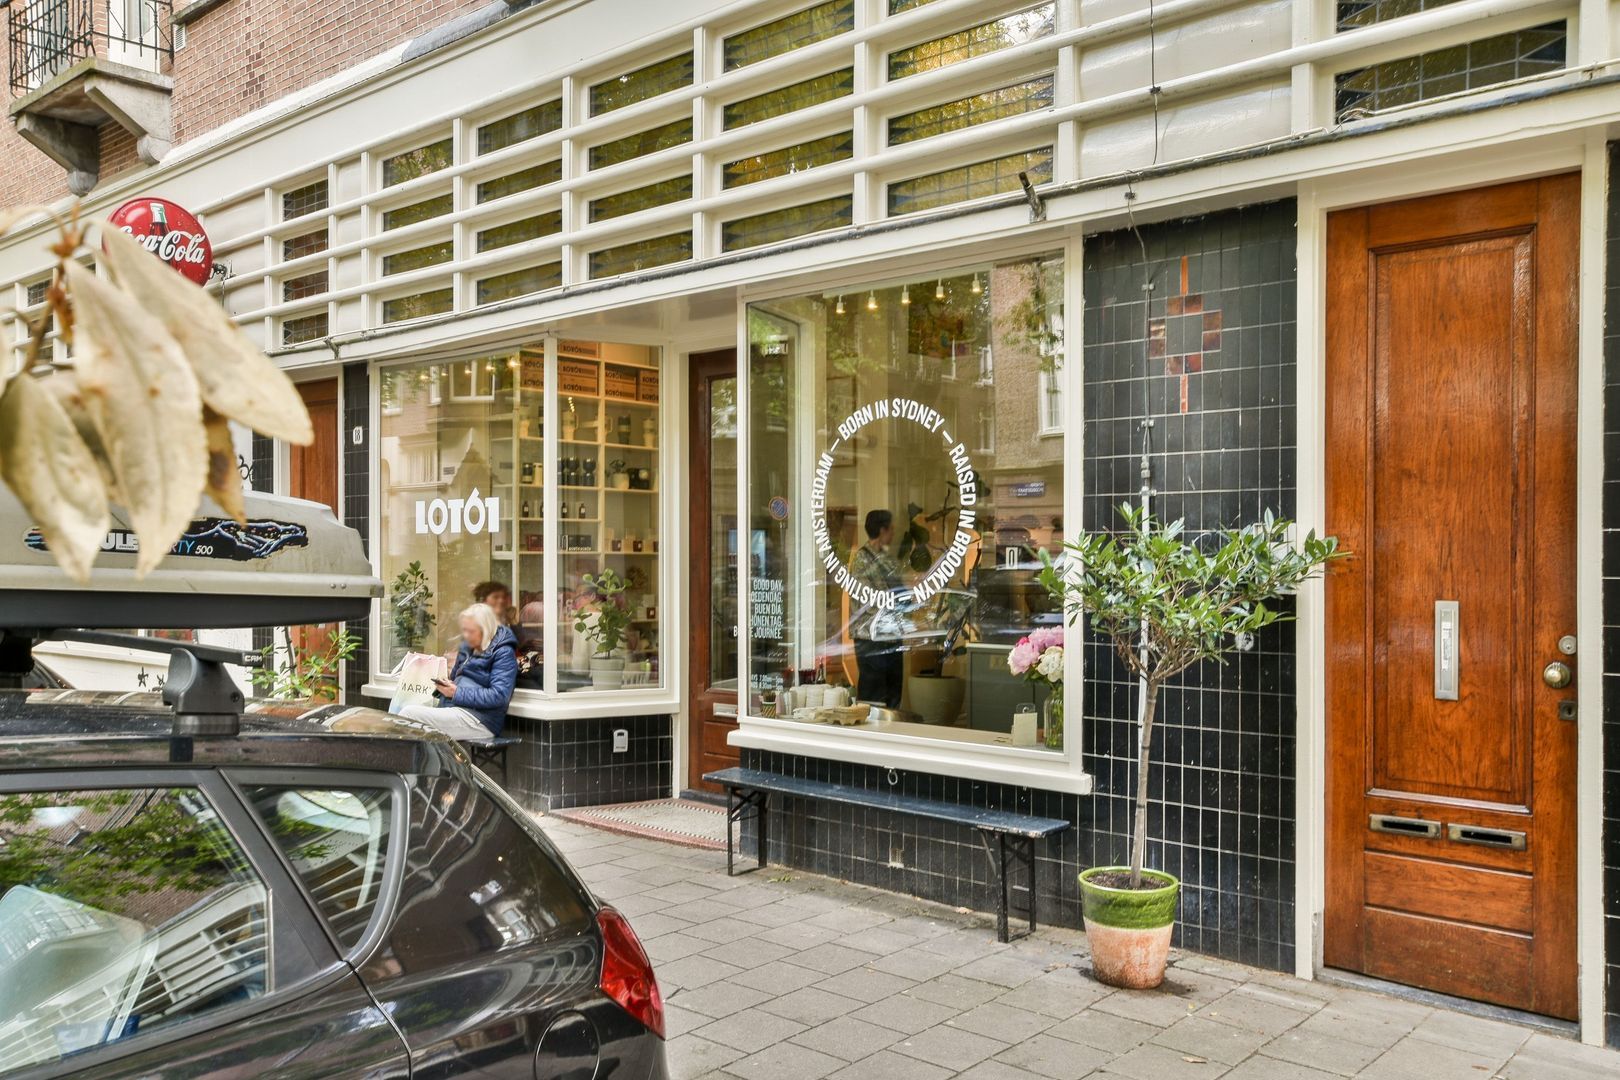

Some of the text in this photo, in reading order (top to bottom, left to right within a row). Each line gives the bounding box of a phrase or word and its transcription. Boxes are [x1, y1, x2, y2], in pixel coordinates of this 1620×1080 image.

[120, 226, 206, 264] ca-Cola
[837, 397, 945, 441] BORN IN SYDNEY
[415, 486, 500, 535] LOT61
[913, 443, 977, 603] RAISED IN BROOKLYN
[100, 532, 139, 551] ULE
[195, 545, 214, 555] 500
[811, 452, 895, 610] ROASTING IN AMSTERDAM
[751, 590, 783, 603] OEDENDAG.
[753, 579, 770, 591] GOOD
[754, 603, 771, 614] BUEN
